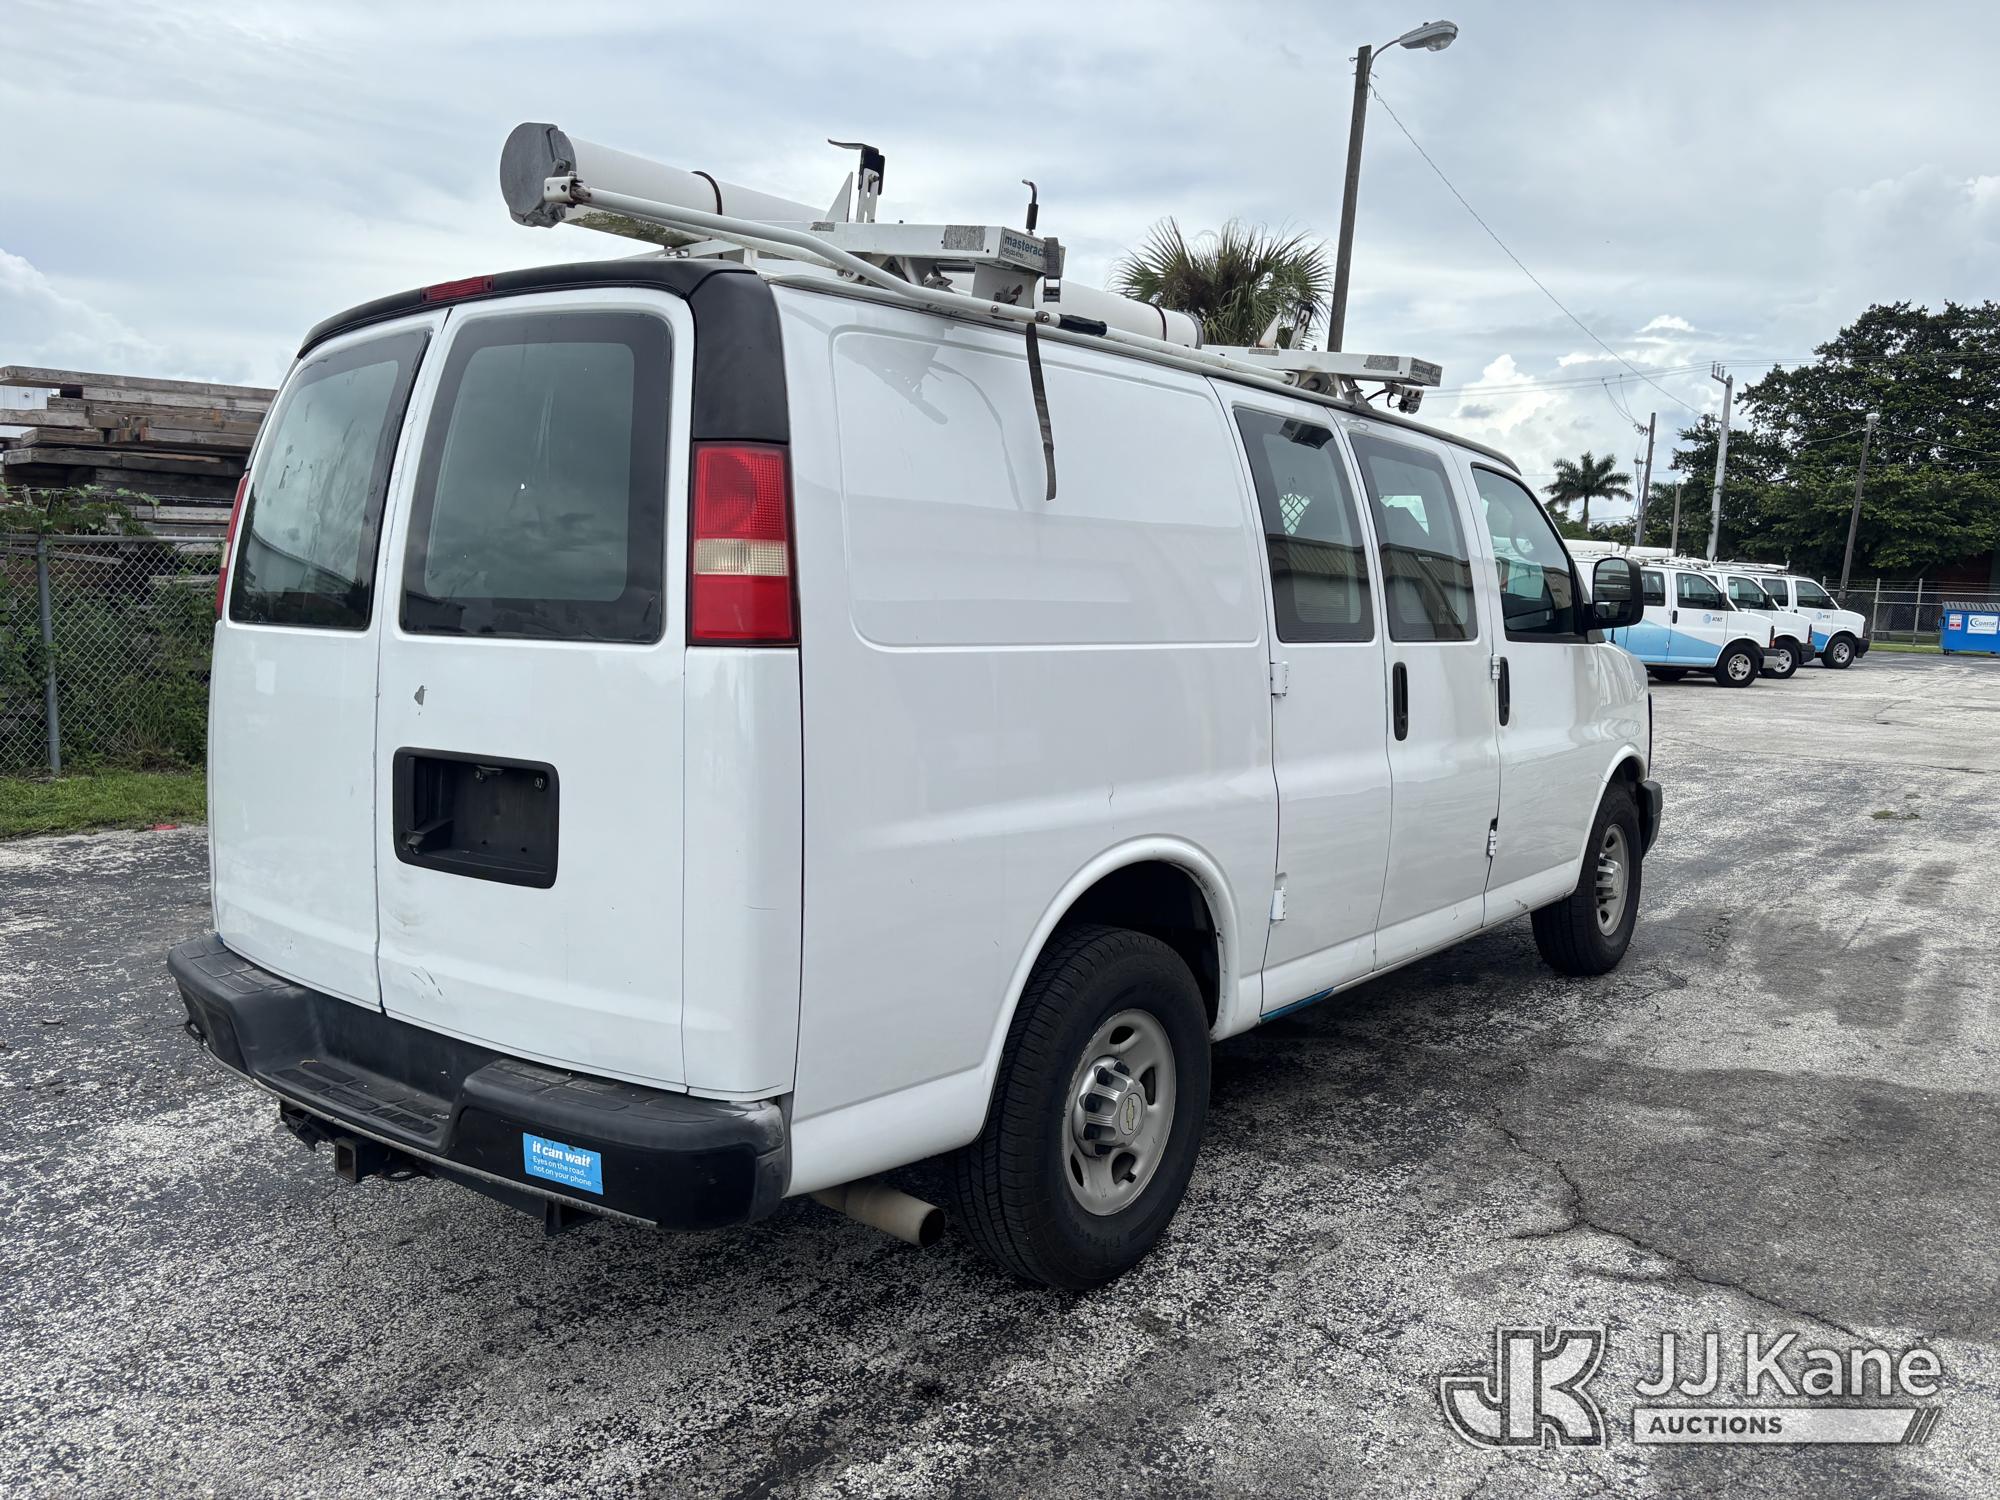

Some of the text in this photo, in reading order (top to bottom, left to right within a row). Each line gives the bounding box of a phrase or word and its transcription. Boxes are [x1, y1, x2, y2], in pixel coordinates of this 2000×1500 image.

[532, 1155, 548, 1167] Eyes
[548, 1160, 557, 1169] on
[557, 1160, 568, 1172] the
[542, 1146, 563, 1160] can
[565, 1152, 591, 1168] wait
[533, 1164, 592, 1187] not on your phone
